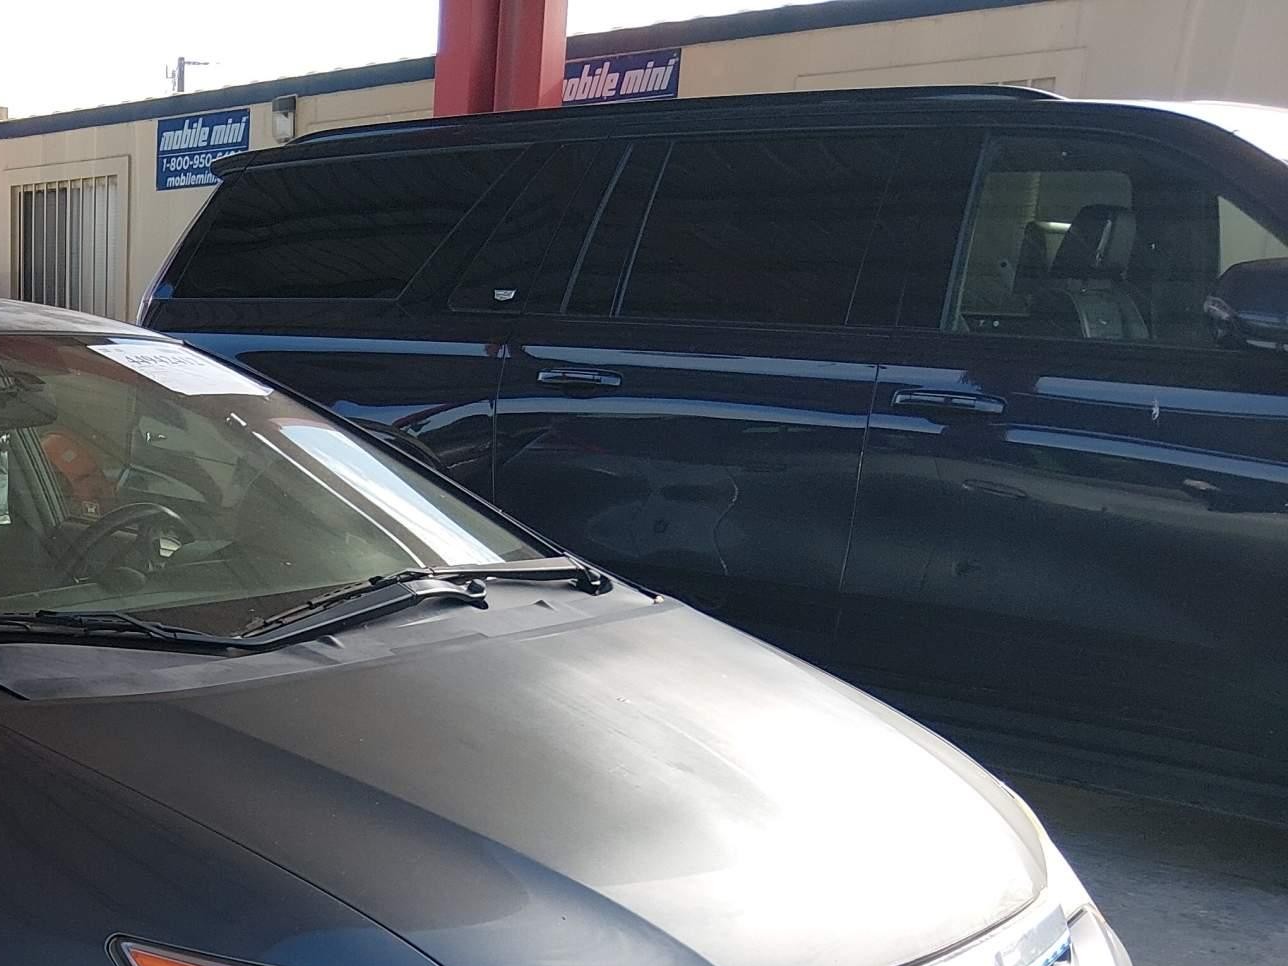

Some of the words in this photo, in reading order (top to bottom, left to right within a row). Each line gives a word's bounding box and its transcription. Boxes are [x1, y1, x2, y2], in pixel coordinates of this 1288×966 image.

[620, 58, 675, 95] mini
[160, 118, 209, 151] mobile
[210, 117, 246, 146] mini
